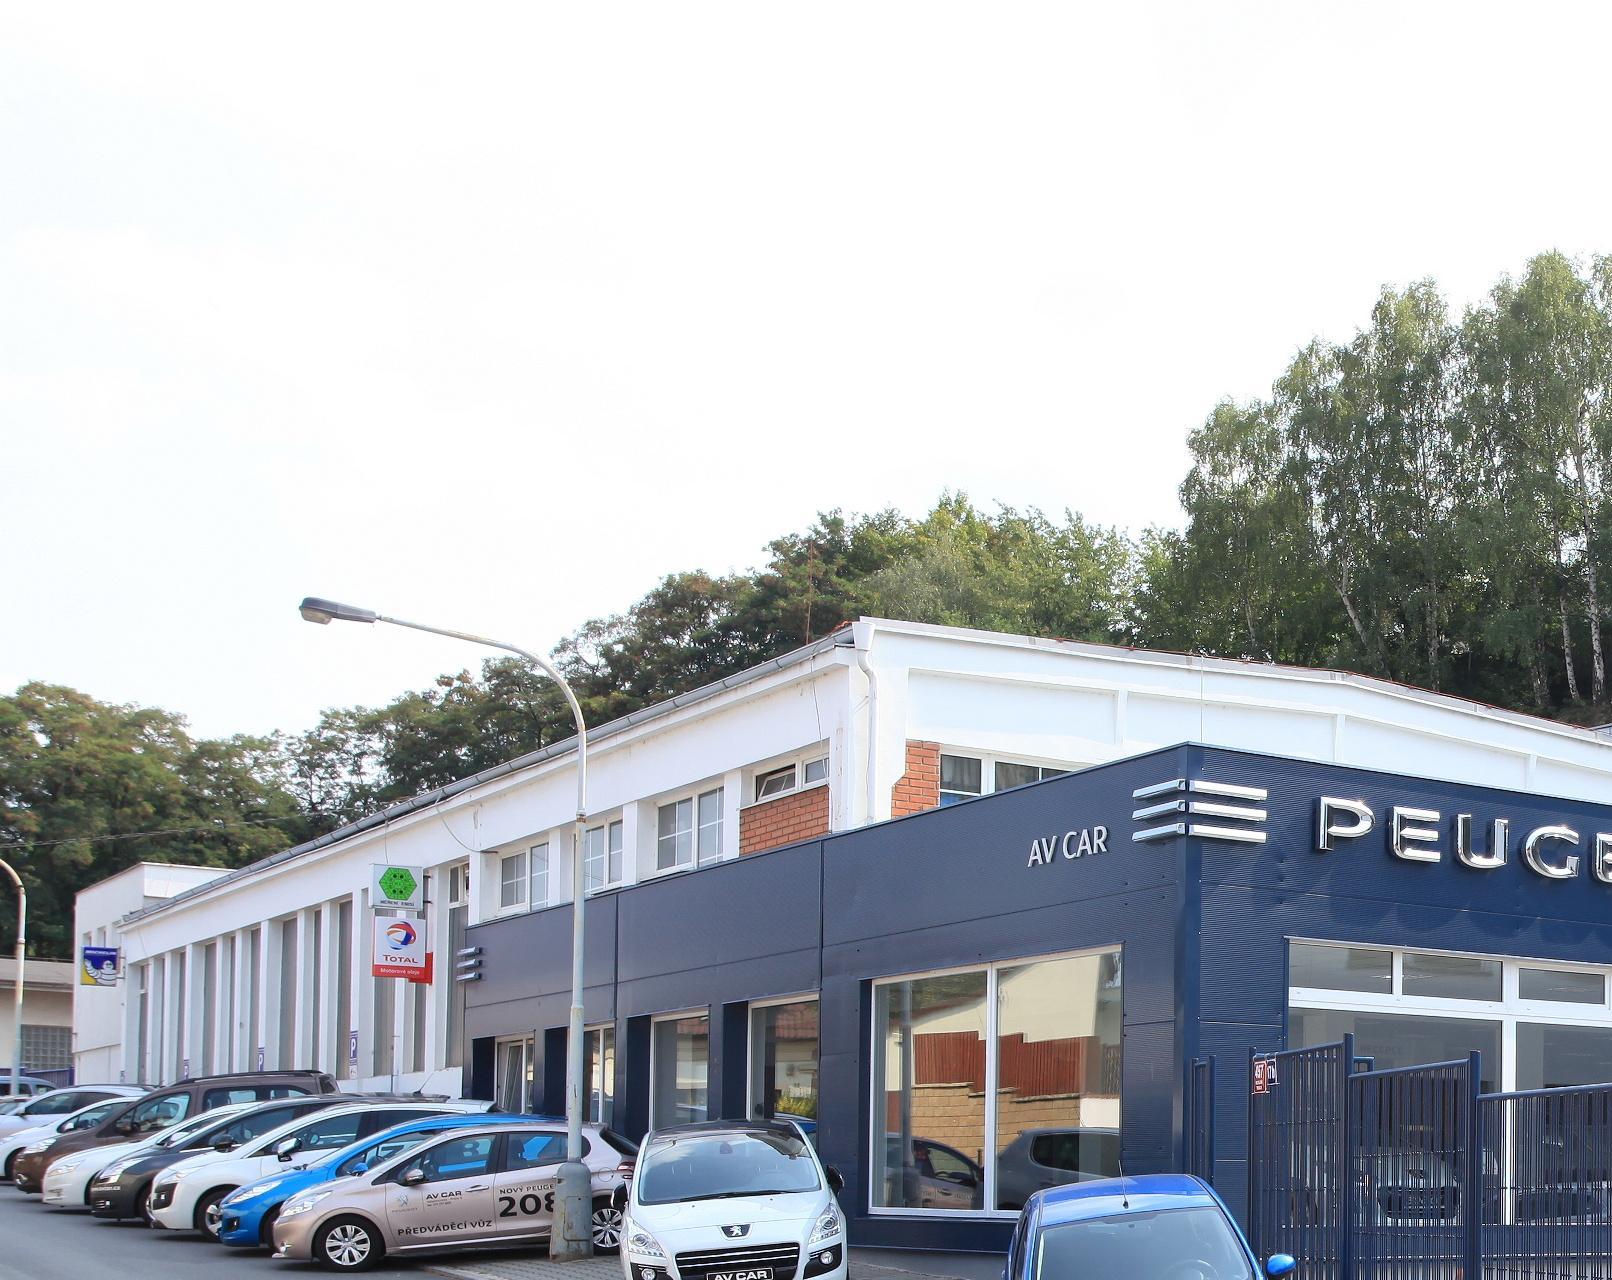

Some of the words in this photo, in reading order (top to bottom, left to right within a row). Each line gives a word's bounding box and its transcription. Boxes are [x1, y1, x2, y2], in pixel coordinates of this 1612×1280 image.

[1027, 835, 1058, 868] AV
[1062, 825, 1108, 860] CAR
[382, 954, 419, 964] TOTAL
[526, 1183, 555, 1192] PEUGE
[426, 1192, 439, 1200] AV
[440, 1190, 462, 1198] CAR
[397, 1221, 467, 1236] PŘEDVÁDĚCÍ
[469, 1219, 493, 1228] VŮZ
[735, 1270, 768, 1280] CAR
